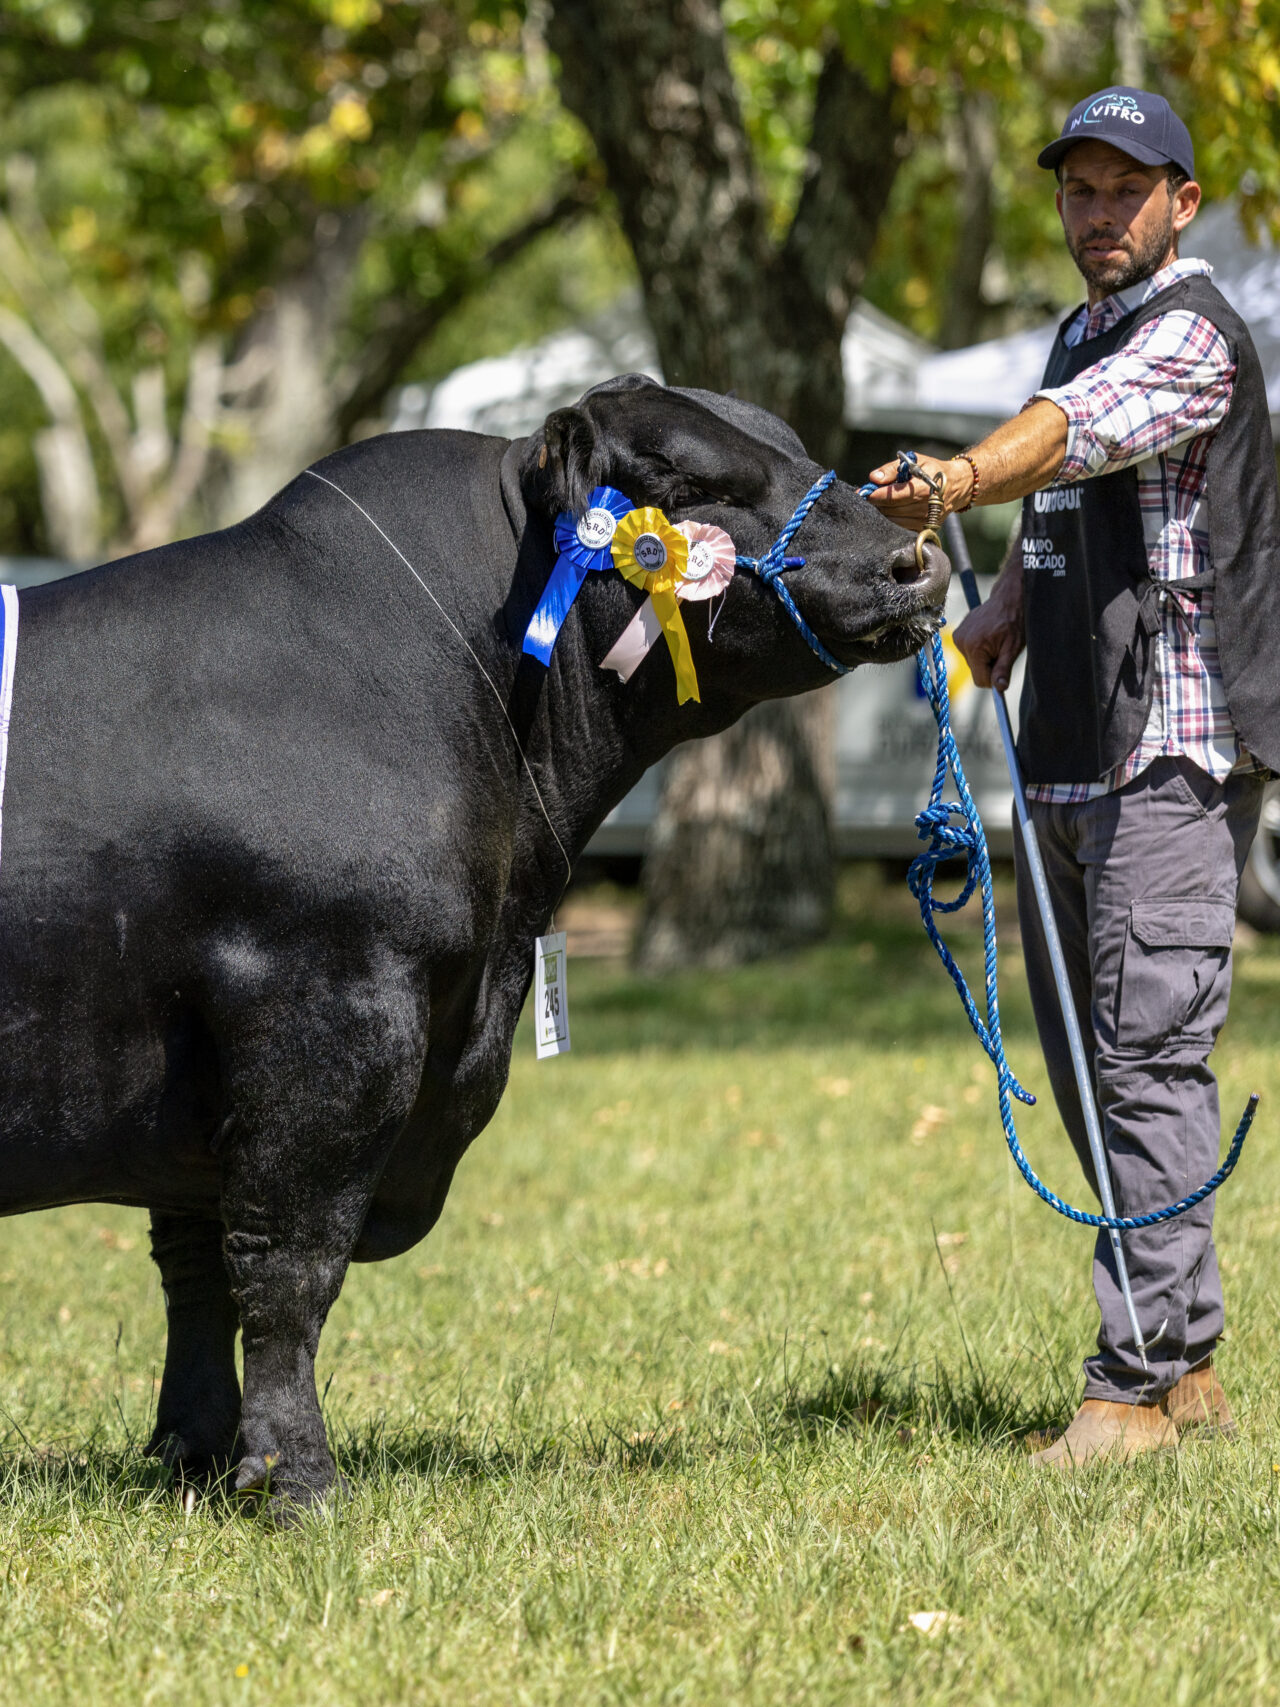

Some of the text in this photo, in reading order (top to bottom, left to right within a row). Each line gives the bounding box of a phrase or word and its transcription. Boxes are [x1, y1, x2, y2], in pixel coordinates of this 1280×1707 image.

[1092, 105, 1145, 125] VITRO
[641, 547, 658, 558] SRD
[1022, 537, 1053, 553] AMPO
[687, 554, 705, 568] RD
[1023, 554, 1066, 569] ERCADO
[545, 986, 559, 1019] 245
